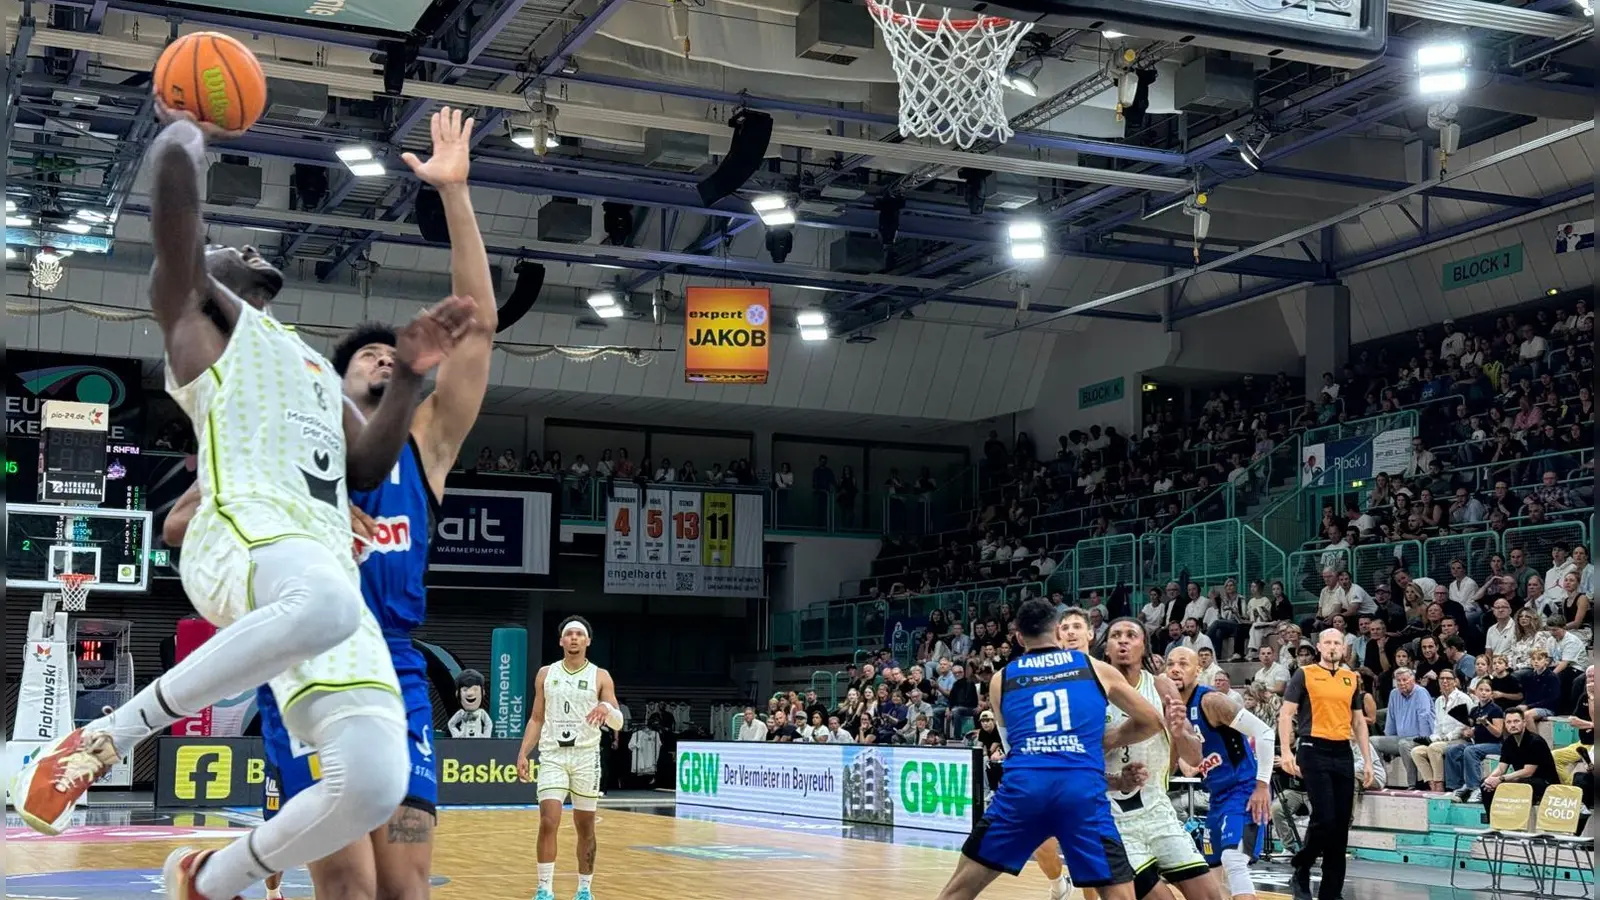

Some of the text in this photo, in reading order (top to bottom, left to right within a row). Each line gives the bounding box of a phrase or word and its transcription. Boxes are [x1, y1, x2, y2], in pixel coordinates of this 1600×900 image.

[1453, 253, 1510, 282] BLOCK J
[689, 310, 743, 320] expert
[689, 329, 767, 347] JAKOB
[1082, 384, 1110, 404] BLOCK
[1334, 454, 1360, 470] Block
[437, 507, 505, 542] ait
[614, 508, 631, 537] 4
[647, 509, 663, 539] 5
[672, 511, 700, 540] 13
[706, 512, 729, 540] 11
[436, 546, 505, 554] WÄRMEPUMPEN
[607, 569, 667, 580] engelhardt
[1018, 651, 1073, 668] LAWSON
[1032, 670, 1080, 682] SCHUBERT
[38, 664, 56, 738] Piotrowski
[564, 701, 570, 714] 0
[1033, 688, 1072, 733] 21
[510, 696, 522, 733] Klick
[679, 752, 969, 817] GBW Der Vermieter in Bayreuth GBW
[1547, 796, 1578, 809] TEAM
[1544, 808, 1575, 820] GOLD
